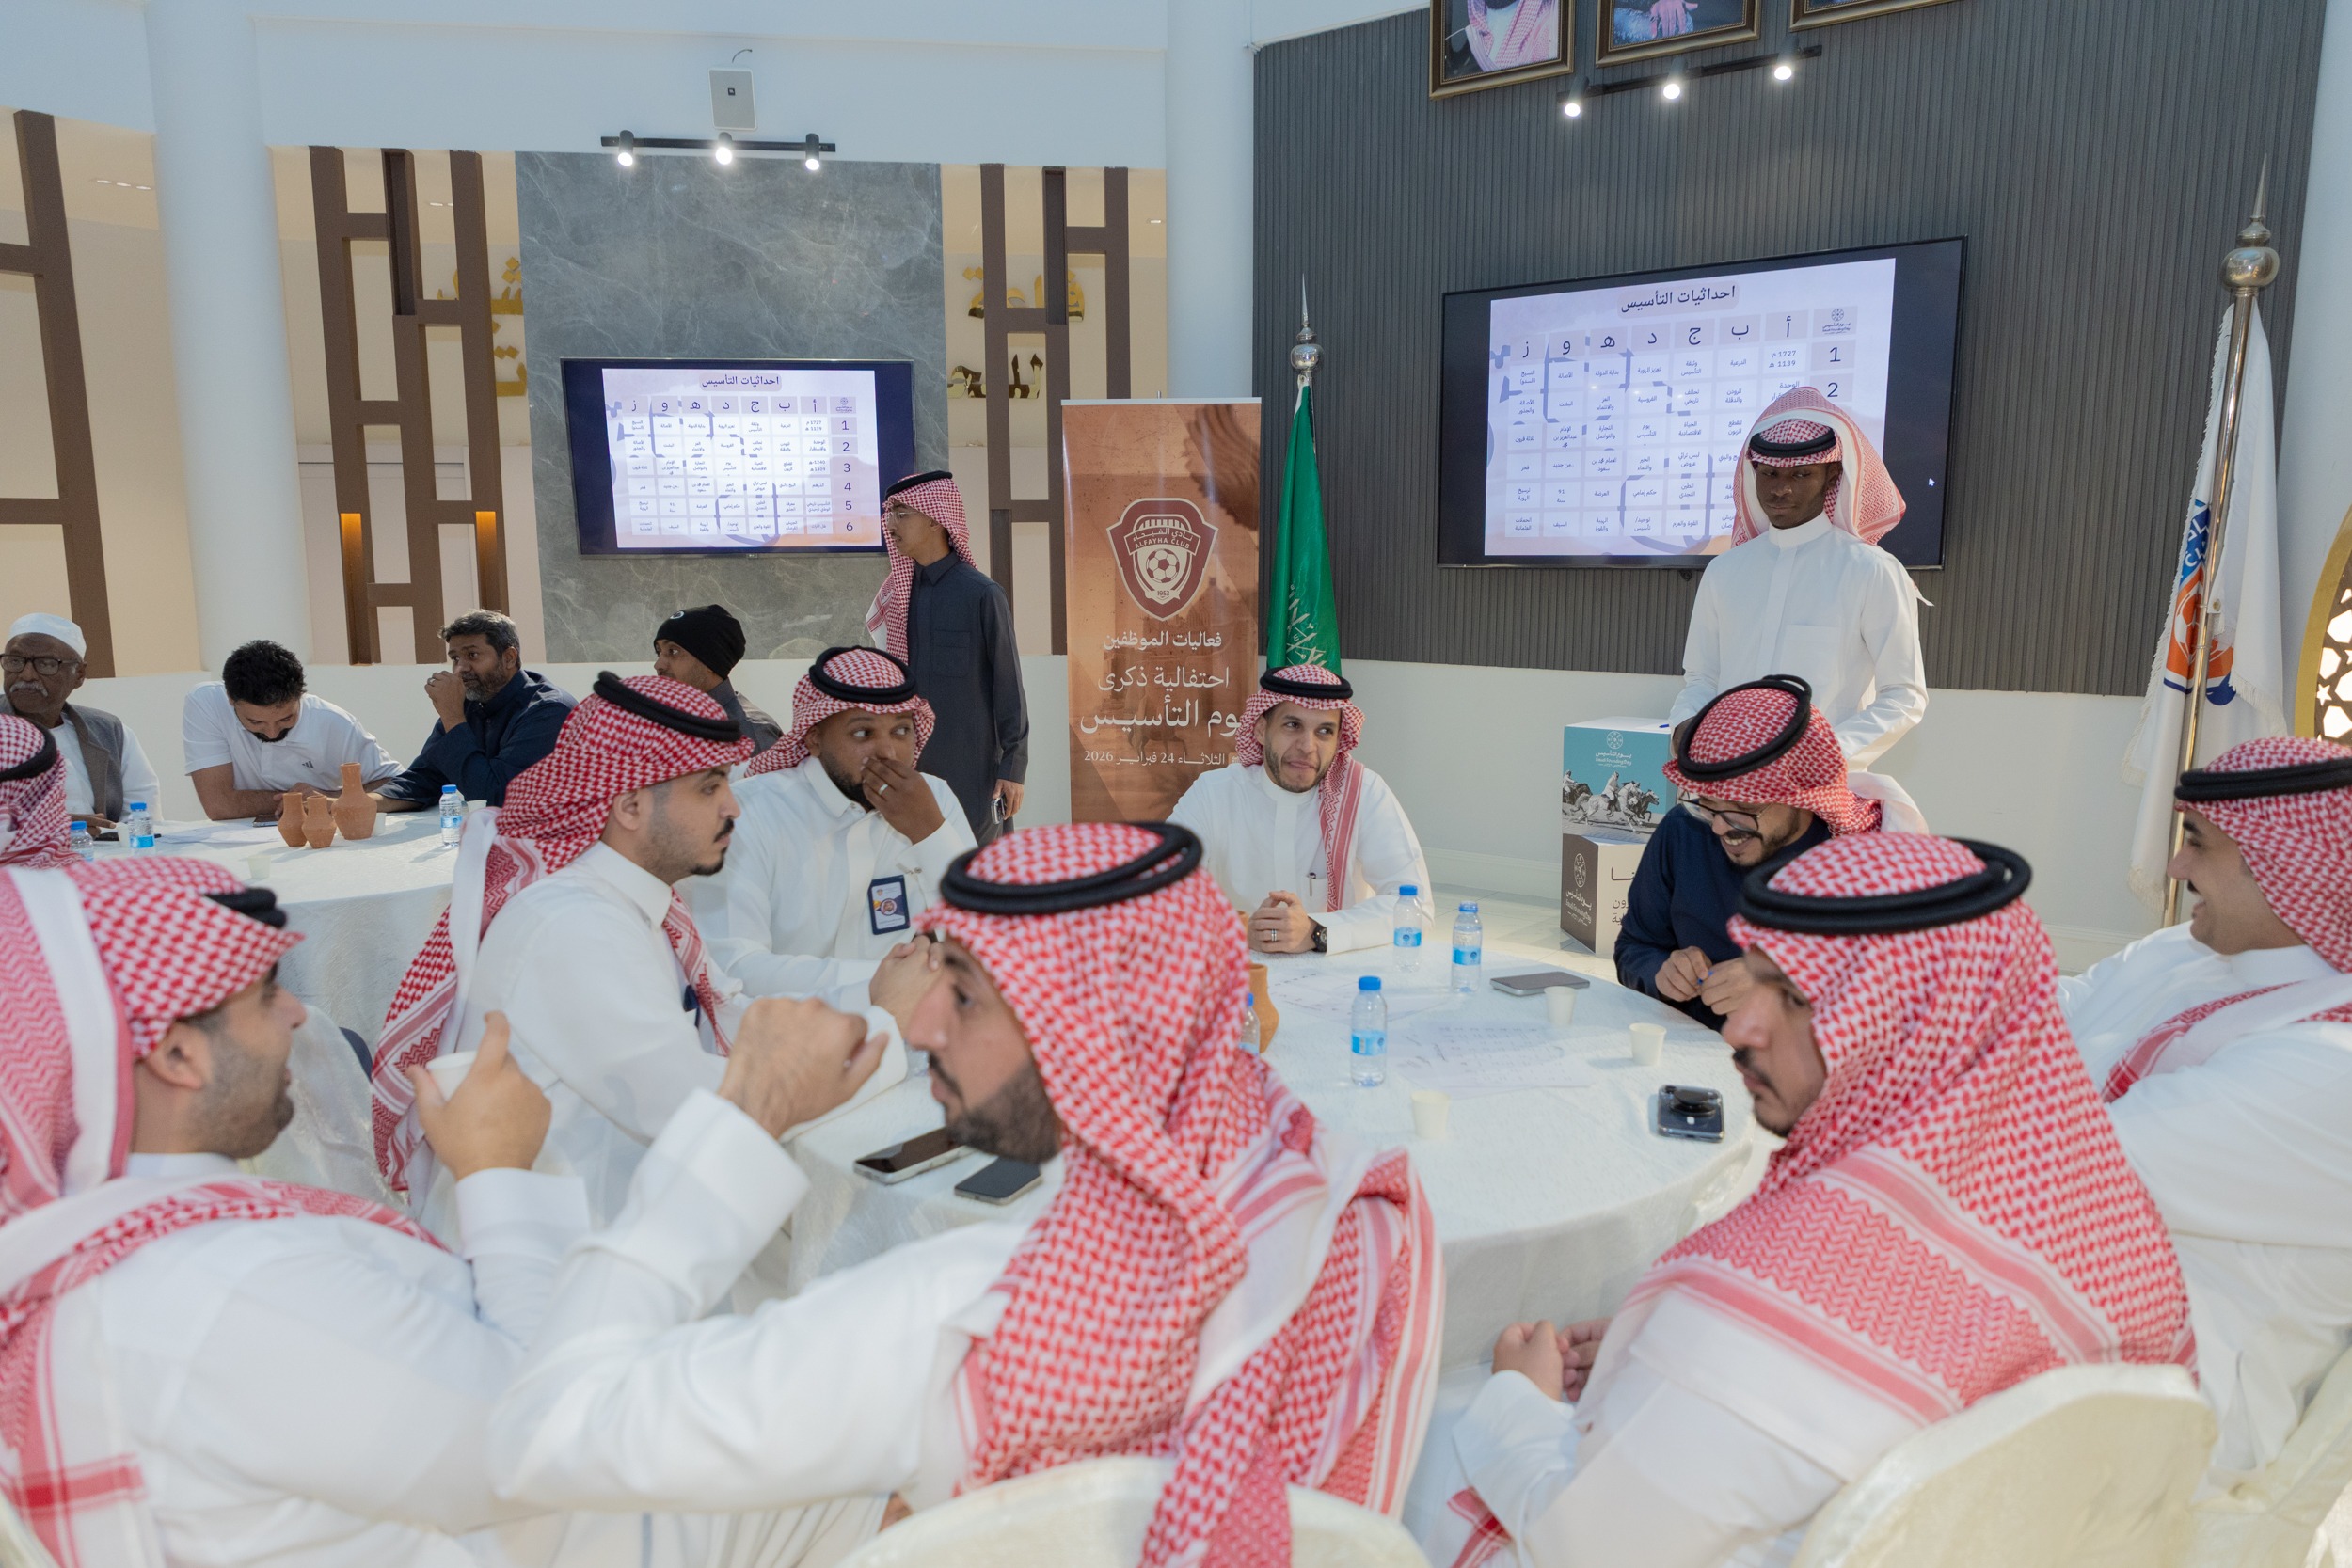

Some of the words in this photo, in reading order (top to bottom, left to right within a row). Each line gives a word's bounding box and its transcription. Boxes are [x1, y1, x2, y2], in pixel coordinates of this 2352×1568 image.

[1622, 291, 1672, 312] التأسيس
[1678, 286, 1735, 306] احداثيات
[1731, 325, 1749, 340] ب
[1787, 316, 1791, 337] أ
[1648, 333, 1657, 343] د
[1689, 327, 1701, 345] ج
[1523, 342, 1529, 357] ز
[1563, 341, 1570, 355] و
[1830, 347, 1840, 362] 1
[702, 374, 737, 387] التأسيس
[741, 376, 779, 387] احداثيات
[1827, 383, 1837, 397] 2
[632, 400, 636, 411] ز
[662, 403, 668, 411] و
[751, 402, 759, 412] ج
[779, 403, 790, 411] ب
[813, 399, 816, 412] أ
[842, 420, 849, 430] 1
[843, 442, 850, 451] 2
[844, 463, 850, 472] 3
[844, 482, 851, 491] 4
[845, 500, 852, 510] 5
[847, 522, 853, 531] 6
[1134, 528, 1170, 542] الفيحاء
[1171, 531, 1193, 541] نادي
[1135, 538, 1168, 548] ALFAYHA
[1171, 538, 1190, 549] CLUB
[1104, 630, 1168, 651] الموظفين
[1173, 631, 1222, 650] فعاليات
[1098, 666, 1148, 691] ذكرى
[1154, 666, 1229, 691] احتفالية
[1081, 694, 1199, 734] التأسيس
[1207, 710, 1242, 738] وم
[1084, 751, 1114, 761] 2026
[1116, 751, 1157, 766] فبراير
[1160, 753, 1174, 763] 24
[1178, 752, 1225, 765] الثلاثاء
